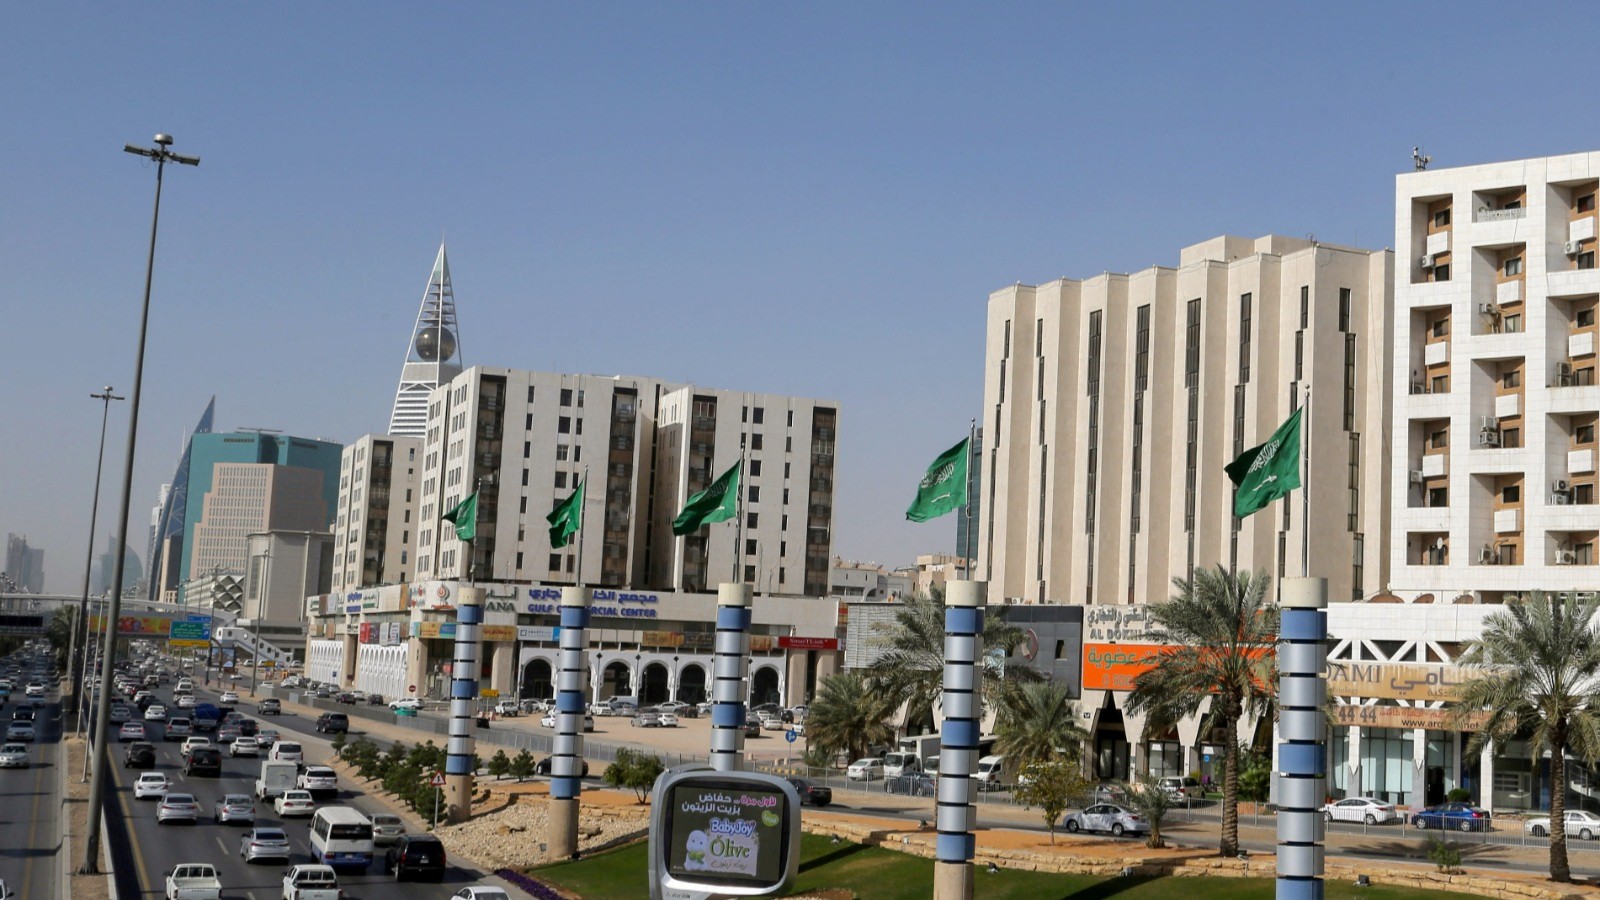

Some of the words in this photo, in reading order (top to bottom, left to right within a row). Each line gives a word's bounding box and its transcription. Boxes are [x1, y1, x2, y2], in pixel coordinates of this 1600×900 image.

[618, 594, 657, 604] مجمع
[486, 602, 516, 613] ANA
[528, 603, 552, 613] GULF
[556, 605, 618, 616] CRCIAL
[620, 607, 657, 618] CENTER
[1090, 628, 1104, 640] AL
[1088, 647, 1136, 669] عضوية
[1338, 706, 1355, 723] 44
[1359, 707, 1377, 724] 44
[698, 792, 732, 803] حفاض
[681, 801, 716, 814] الزيتون
[716, 804, 741, 816] بزيت
[711, 818, 756, 837] BabyJoy
[709, 837, 751, 859] Olive
